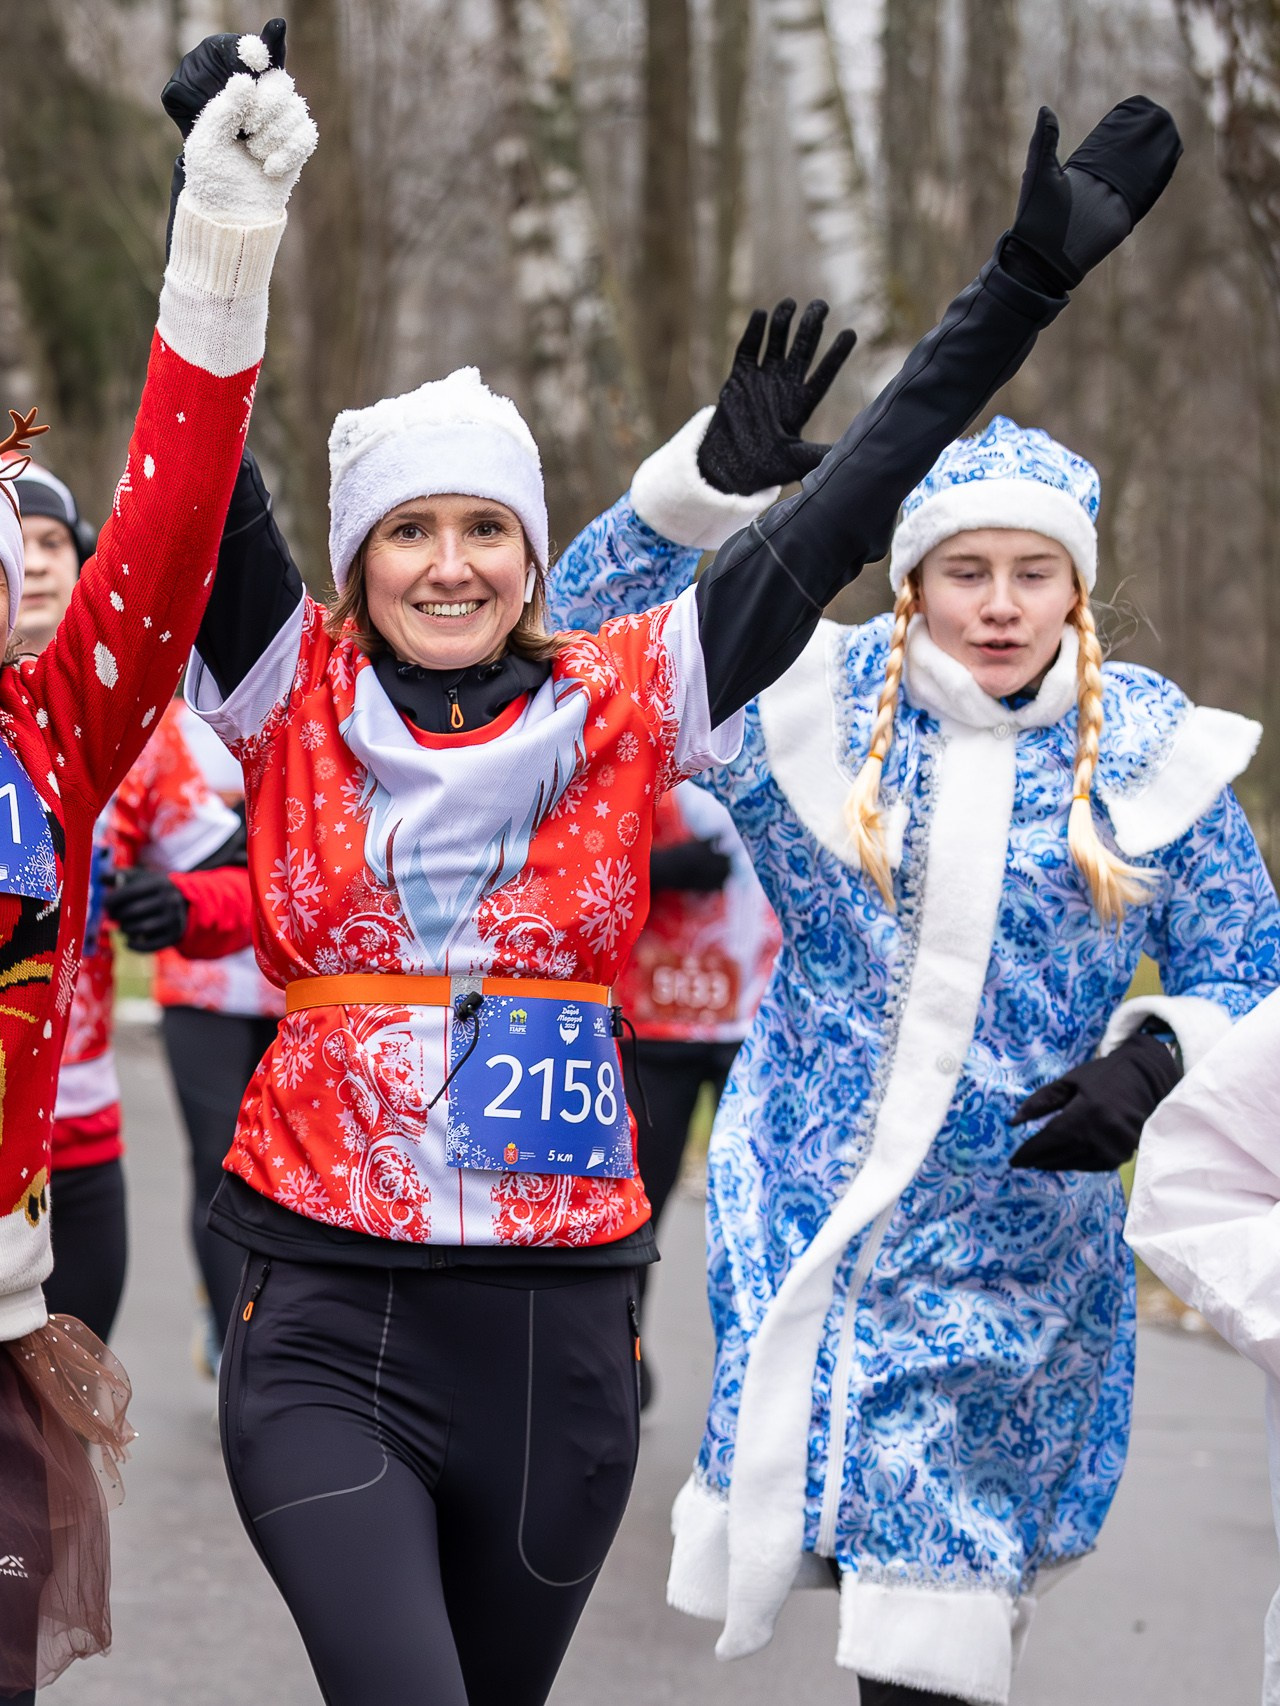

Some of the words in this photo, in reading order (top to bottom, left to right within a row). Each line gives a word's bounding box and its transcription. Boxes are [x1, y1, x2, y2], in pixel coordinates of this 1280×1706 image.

[484, 1054, 617, 1126] 2158
[547, 1150, 556, 1161] 5
[556, 1153, 573, 1162] км
